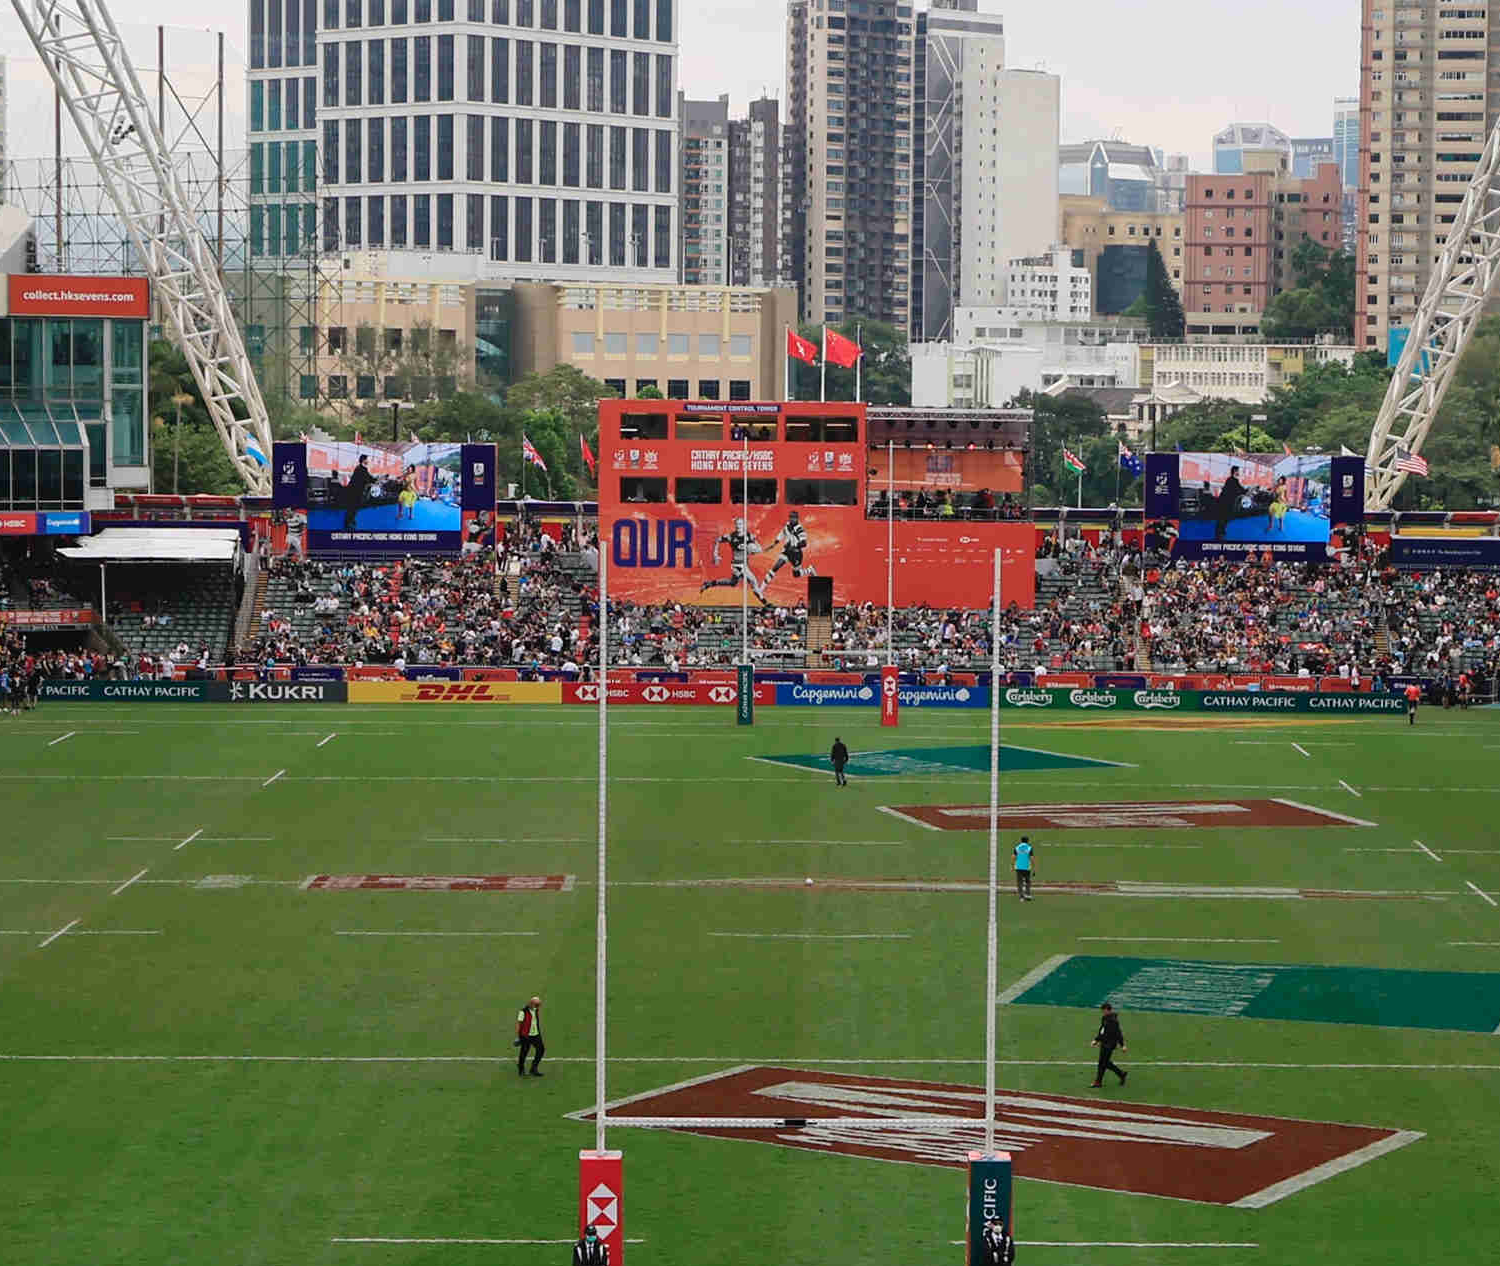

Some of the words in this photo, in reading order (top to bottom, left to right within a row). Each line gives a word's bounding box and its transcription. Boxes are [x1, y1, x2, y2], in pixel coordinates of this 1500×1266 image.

[23, 290, 134, 302] collect.hksevens.com
[691, 450, 721, 461] CATHAY
[691, 461, 715, 472] HONG
[716, 461, 740, 472] KONG
[612, 518, 695, 568] OUR
[47, 685, 91, 697] PACIFIC
[103, 685, 153, 698] CATHAY
[154, 685, 201, 698] PACIFIC
[248, 684, 325, 700] KUKRI
[417, 684, 500, 701] DHL
[672, 690, 696, 699] HSBC
[793, 685, 858, 704] Capgemini
[899, 688, 955, 704] apgemini
[1006, 688, 1053, 707] Carlsberg
[1069, 689, 1116, 708] Carlsberg
[1134, 690, 1180, 708] Carlsberg
[1203, 696, 1249, 707] CATHAY
[1251, 696, 1296, 707] PACIFIC
[1309, 697, 1355, 709] CATHAY
[1357, 698, 1403, 710] PACIFIC
